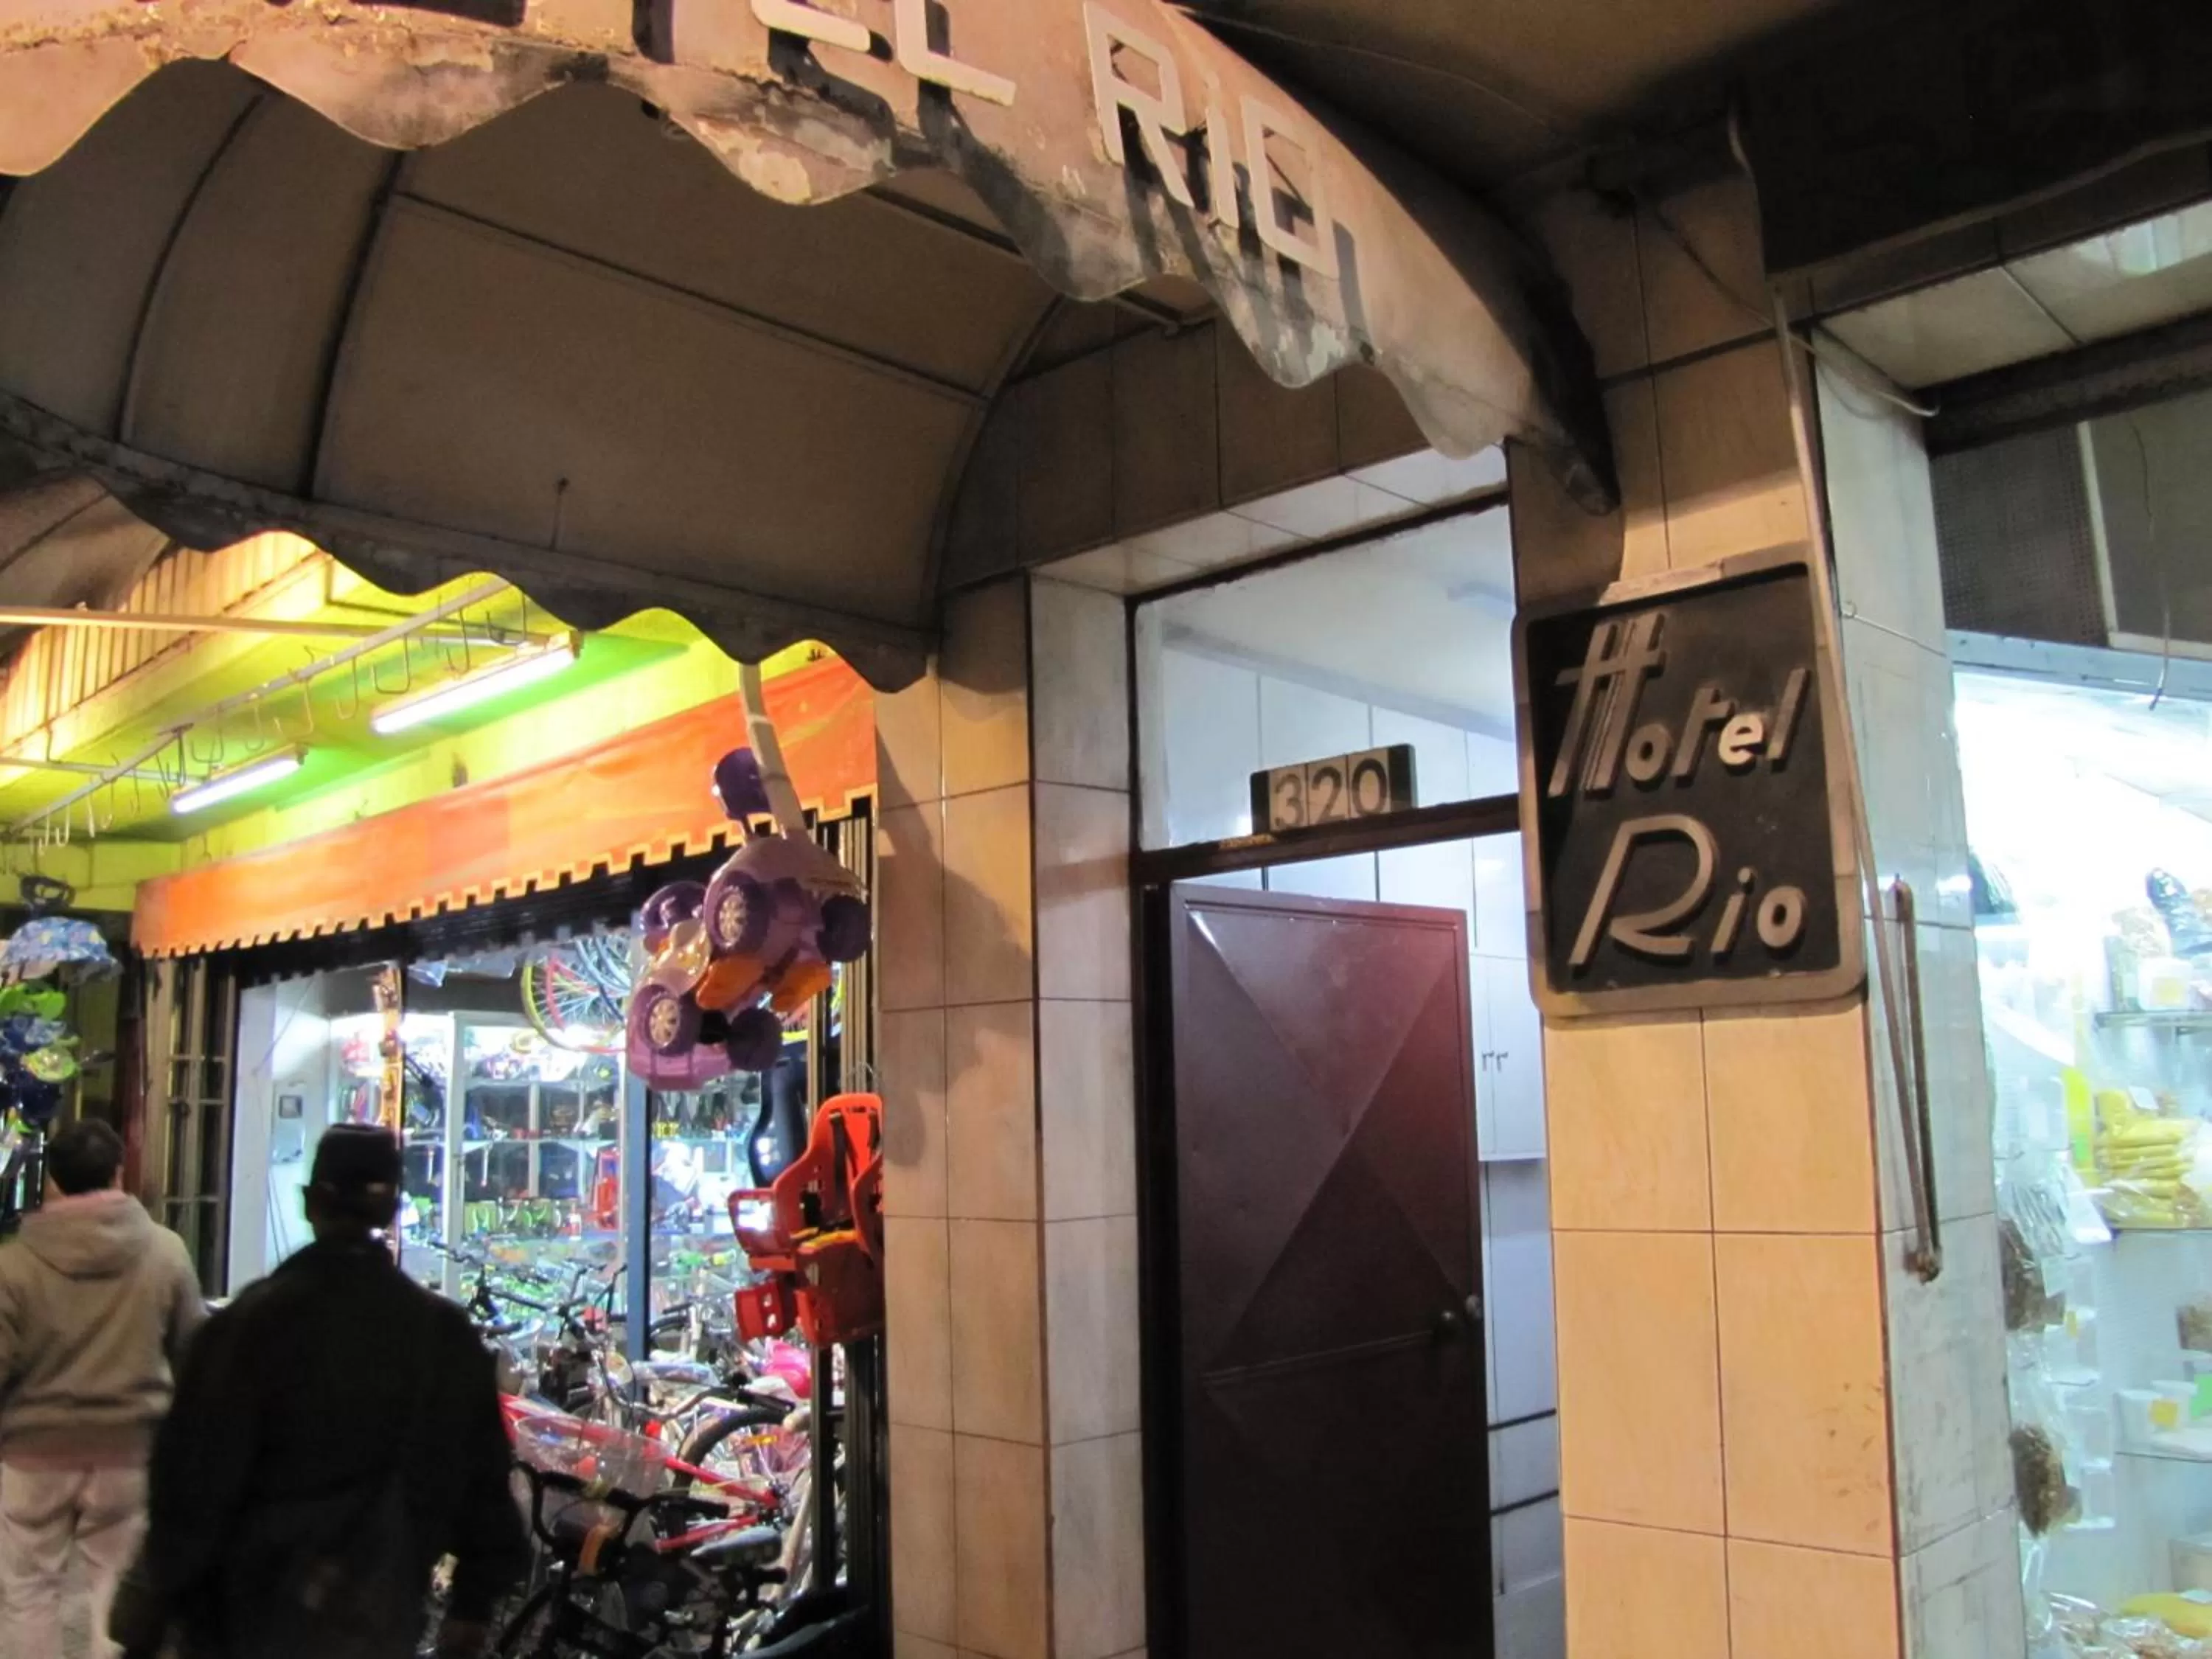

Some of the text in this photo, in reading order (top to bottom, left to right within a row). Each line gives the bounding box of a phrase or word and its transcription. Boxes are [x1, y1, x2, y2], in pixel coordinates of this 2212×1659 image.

[1548, 612, 1807, 797] Hotel
[1275, 758, 1388, 827] 320
[1568, 814, 1806, 964] Rio
